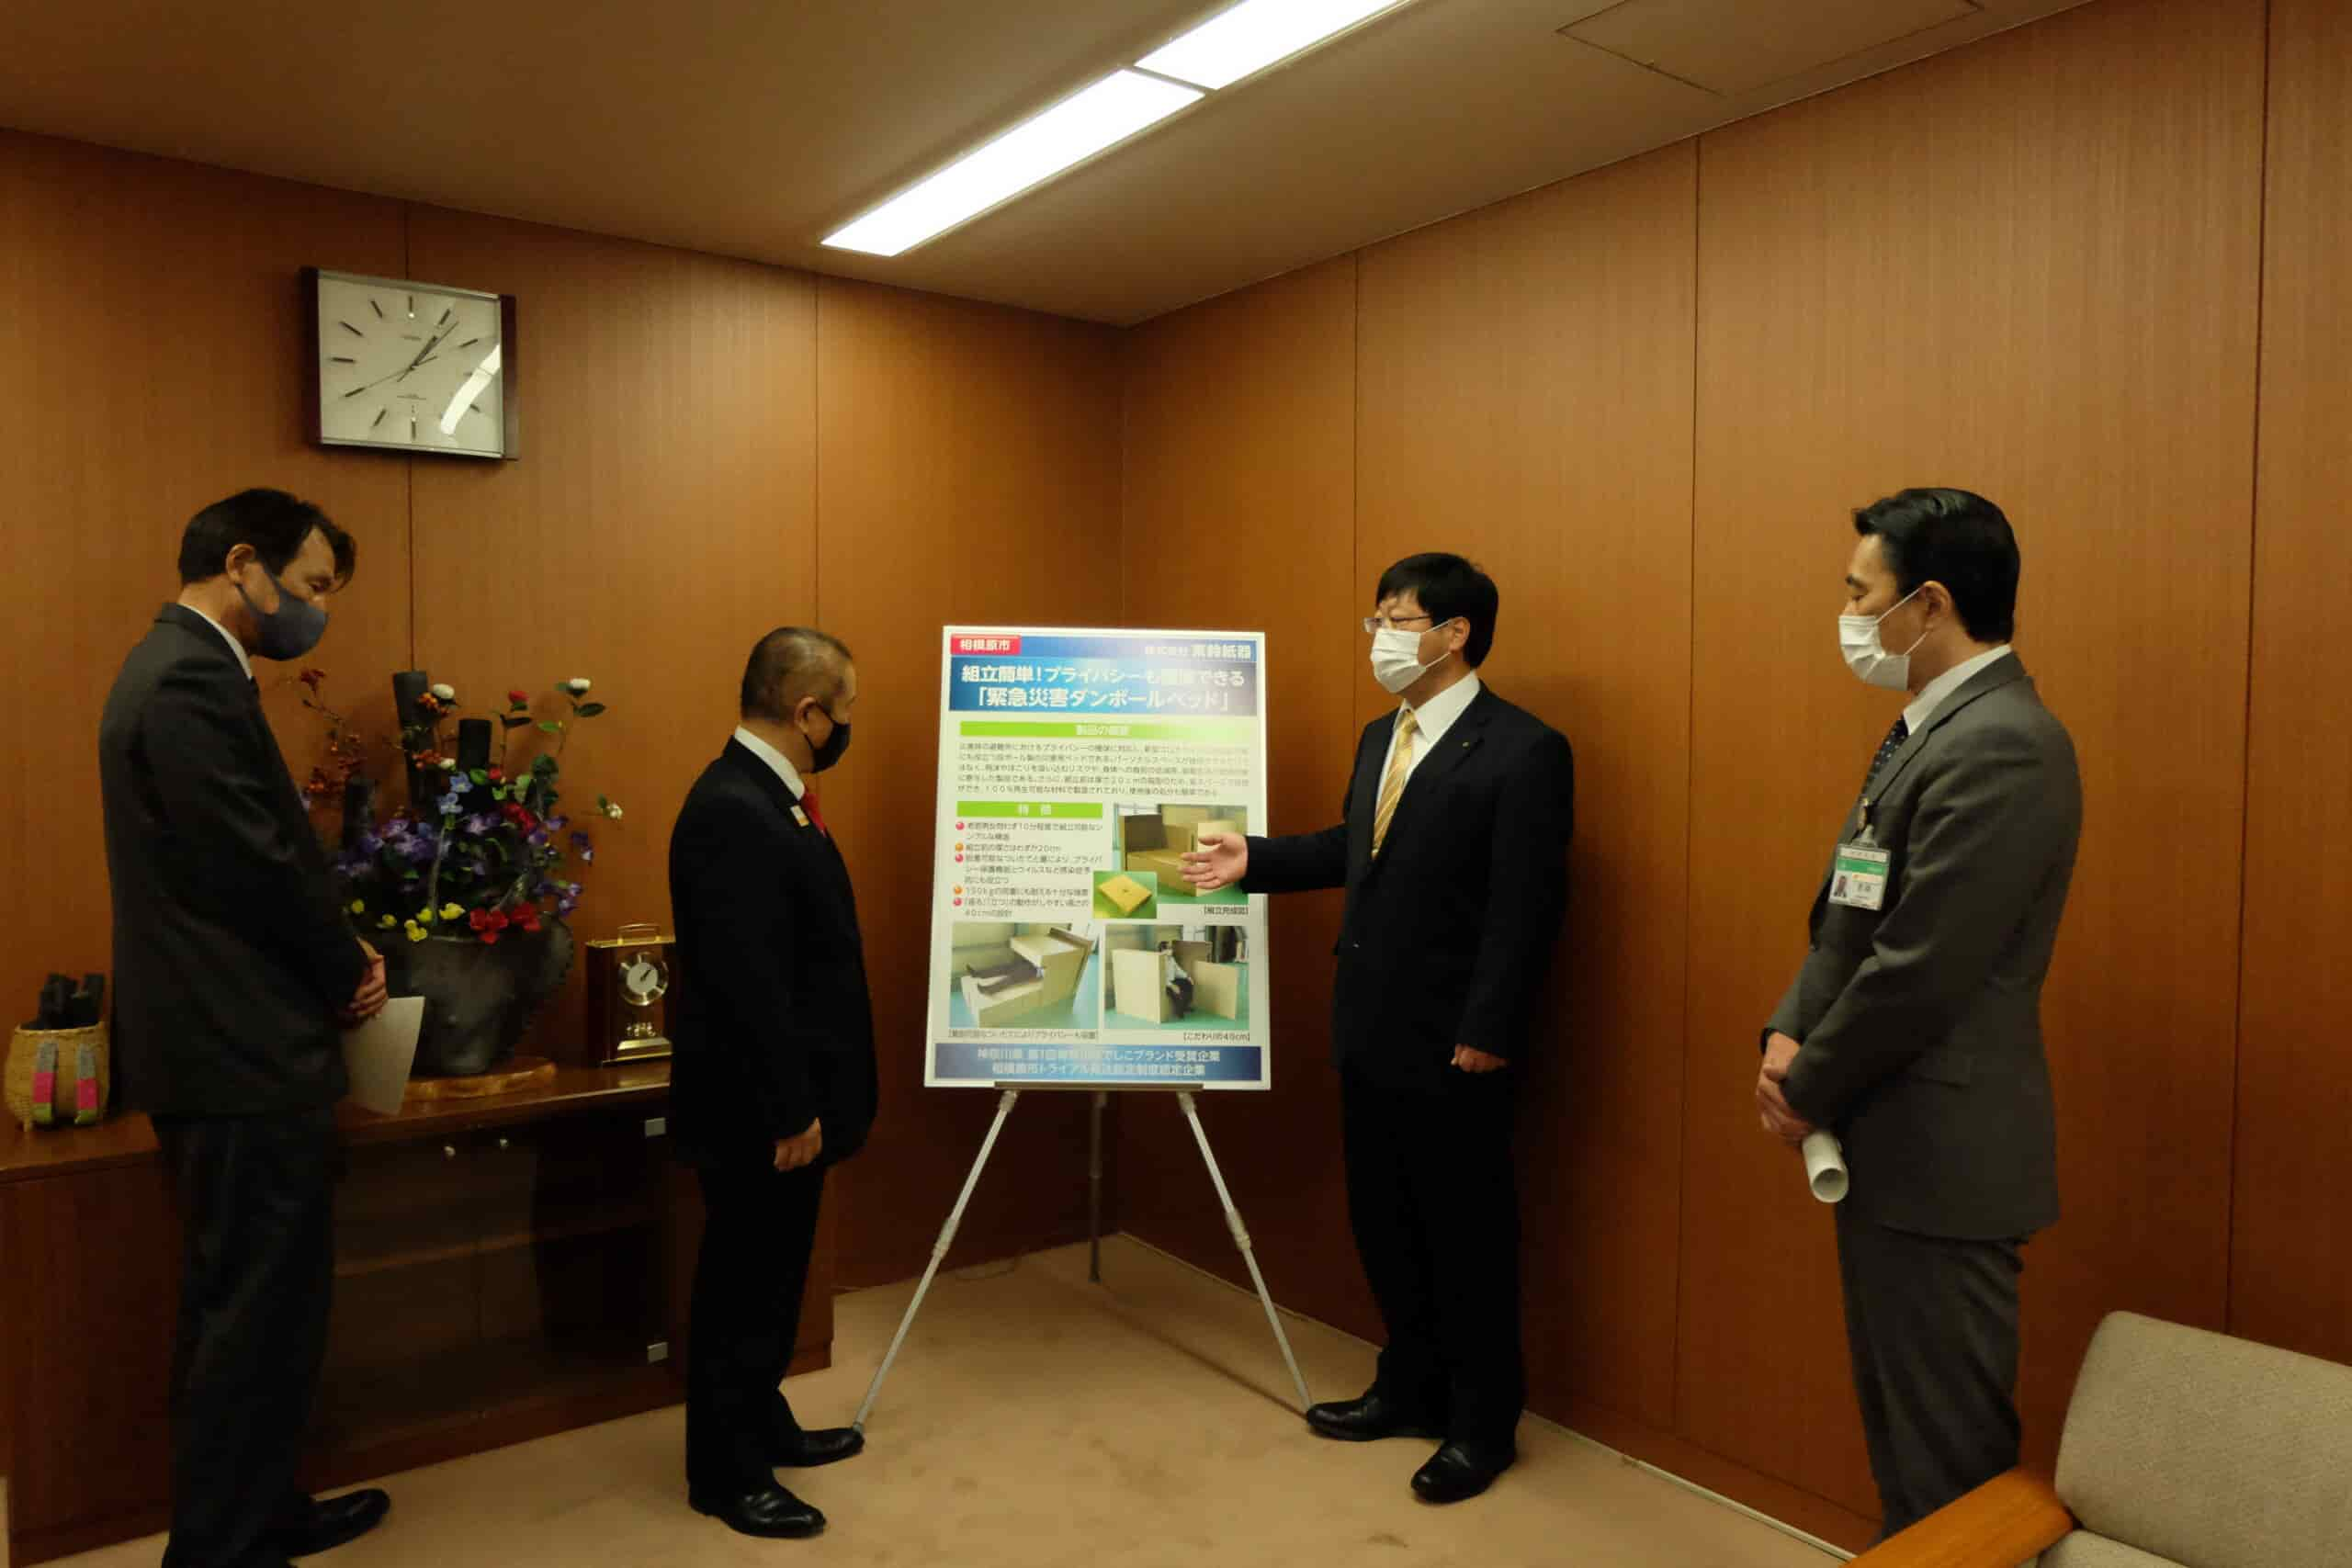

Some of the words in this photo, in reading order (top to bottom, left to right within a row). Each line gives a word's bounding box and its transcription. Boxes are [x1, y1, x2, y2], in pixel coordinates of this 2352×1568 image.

[960, 638, 1011, 651] 相模原市
[961, 665, 1245, 686] 組立簡単!プライバシーもできる
[978, 686, 1228, 712] 「緊急災害ダンボールベッド」
